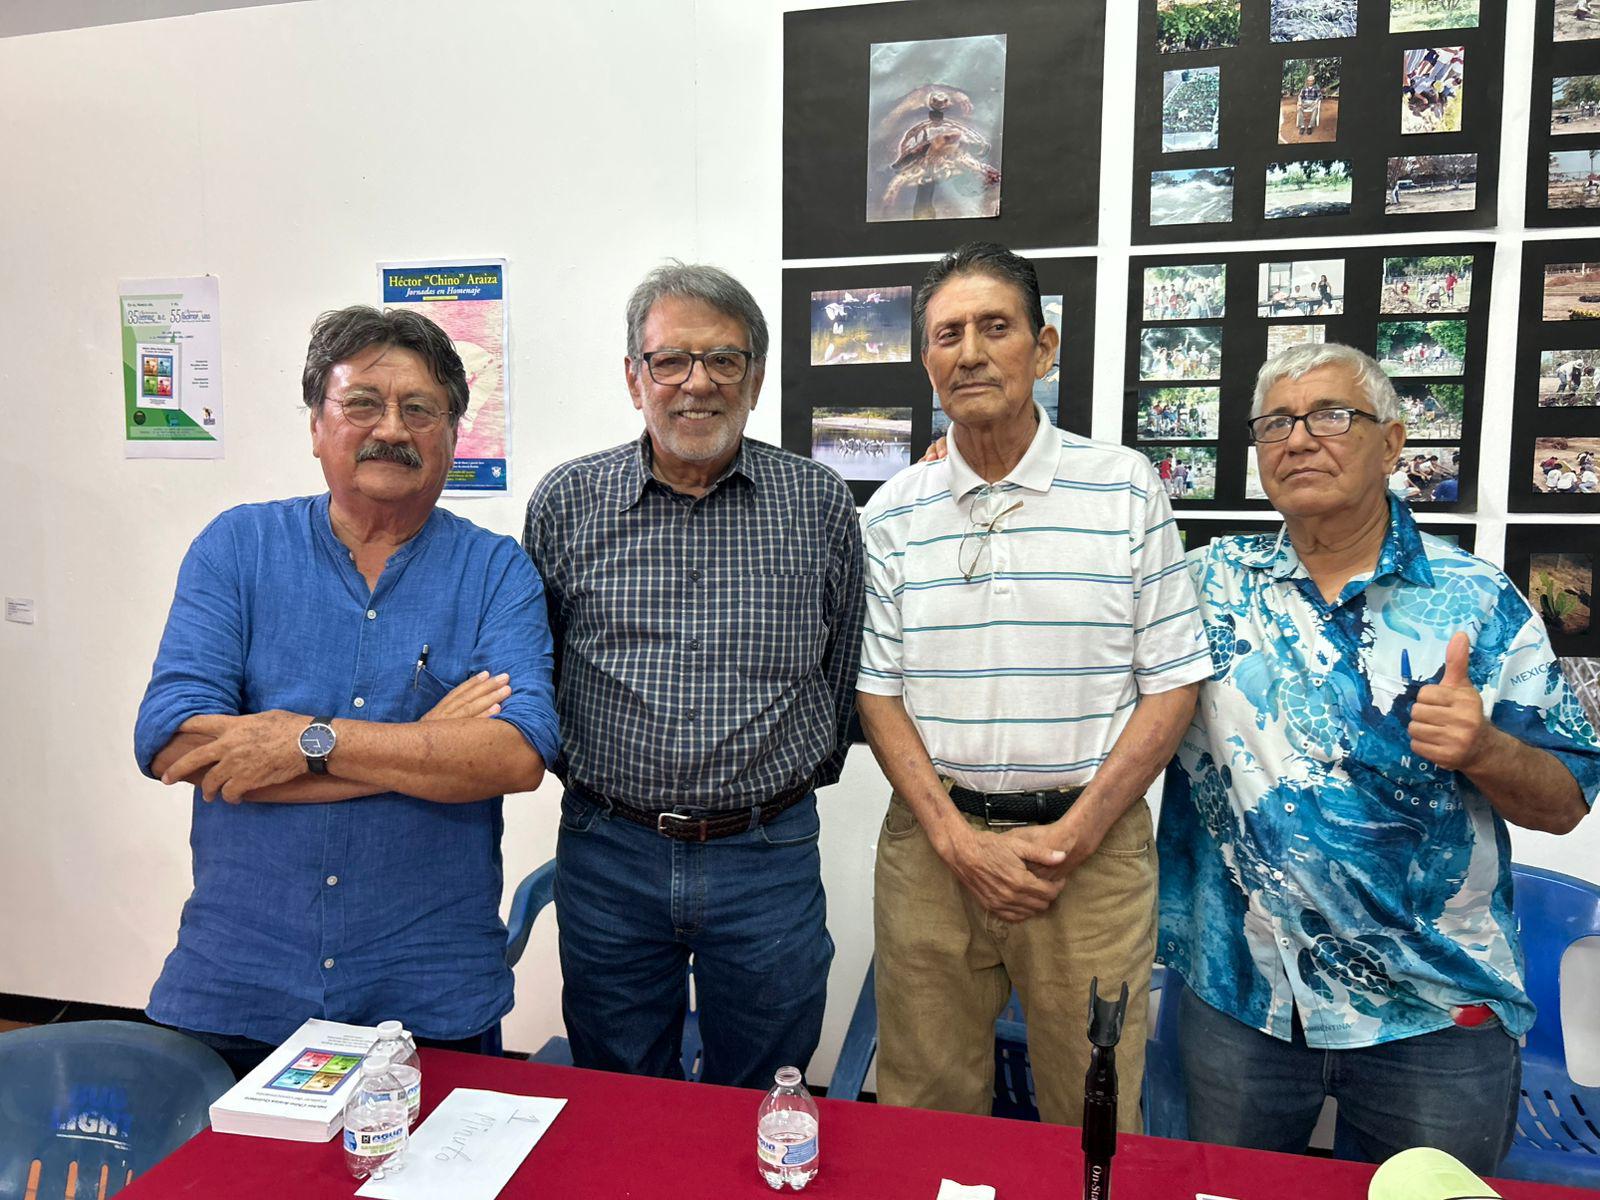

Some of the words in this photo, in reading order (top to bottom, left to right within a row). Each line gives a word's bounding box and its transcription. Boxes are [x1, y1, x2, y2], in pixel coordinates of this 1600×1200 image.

[389, 275, 422, 287] Héctor
[467, 273, 497, 285] Araiza
[405, 287, 435, 297] Jornadas
[446, 286, 481, 296] Homenaje
[127, 309, 139, 324] 35
[170, 308, 181, 323] 55
[435, 1112, 496, 1161] Minuto
